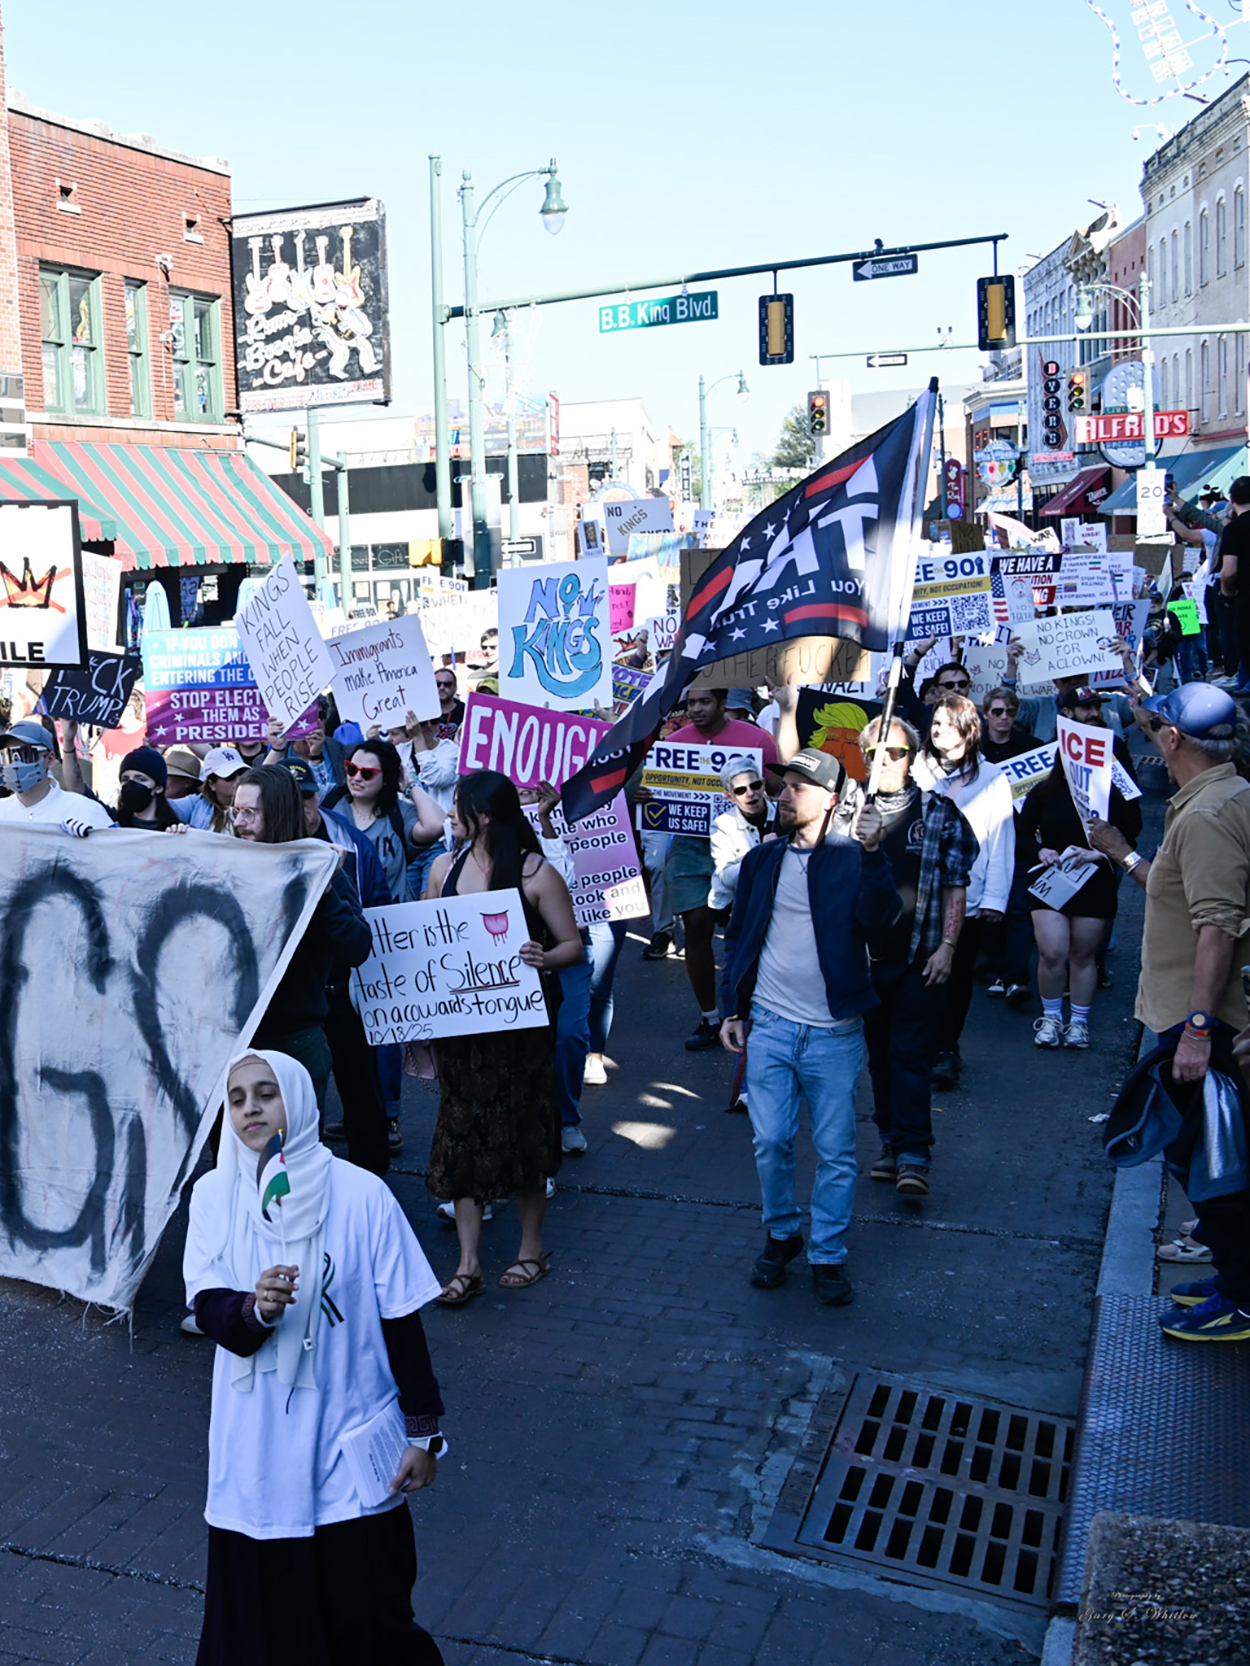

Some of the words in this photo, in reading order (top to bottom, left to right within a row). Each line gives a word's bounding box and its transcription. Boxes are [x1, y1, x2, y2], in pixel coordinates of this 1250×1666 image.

[870, 263, 891, 274] ONE
[892, 260, 912, 272] WAY
[601, 304, 636, 331] B.B.
[637, 301, 670, 325] King
[676, 296, 717, 321] Blvd.
[1045, 362, 1059, 446] DYERS
[1082, 413, 1188, 442] ALFRD'S
[1141, 485, 1163, 499] 20
[607, 505, 623, 518] NO
[617, 508, 648, 537] KINGS
[1000, 558, 1017, 574] WE
[1017, 556, 1044, 572] HAVE
[1045, 555, 1054, 571] A
[523, 572, 582, 624] NO
[929, 584, 941, 594] NOT
[942, 580, 984, 592] OCCUPATION!
[240, 562, 291, 637] KINGS
[653, 617, 677, 635] NO
[910, 613, 925, 625] WE
[925, 610, 948, 623] KEEP
[1037, 619, 1053, 634] NO
[1053, 614, 1096, 631] KINGS!
[255, 617, 291, 653] FALL
[912, 625, 924, 637] US
[925, 623, 949, 636] SAFE!
[1038, 633, 1055, 647] NO
[1055, 627, 1099, 644] CROWN
[181, 636, 210, 651] YOU
[261, 627, 301, 680] WHEN
[330, 628, 404, 668] Immigrants
[1056, 642, 1081, 656] FOR
[150, 652, 221, 670] CRIMINALS
[507, 612, 604, 700] KINGS
[988, 659, 1006, 670] NO
[1057, 652, 1106, 671] CLOWN!
[151, 669, 215, 686] ENTERING
[219, 668, 245, 682] THE
[264, 637, 319, 708] PEOPLE
[344, 667, 376, 692] make
[375, 661, 419, 684] America
[51, 685, 125, 722] TRUMP
[170, 691, 211, 710] STOP
[284, 671, 321, 721] RISE
[362, 684, 407, 721] Great
[201, 708, 239, 724] THEM
[243, 707, 260, 721] AS
[465, 703, 610, 794] ENOUG
[644, 746, 700, 771] FREE
[1061, 728, 1106, 768] ICE
[645, 772, 690, 786] OPPORTUNITY,
[692, 777, 705, 786] NOT
[1069, 761, 1093, 793] OUT
[653, 788, 663, 797] THE
[662, 790, 692, 800] MOVEMENT
[668, 803, 683, 816] WE
[684, 804, 708, 818] KEEP
[582, 814, 617, 831] who
[668, 817, 680, 830] US
[681, 819, 708, 832] SAFE!
[570, 832, 628, 855] people
[581, 866, 639, 889] people
[610, 880, 641, 899] and
[581, 908, 611, 924] like
[614, 900, 646, 918] you
[423, 924, 437, 947] is
[436, 908, 470, 944] the
[355, 961, 407, 1003] taste
[414, 958, 437, 993] of
[440, 950, 522, 990] Silence
[363, 1007, 390, 1028] on
[390, 1006, 404, 1024] a
[403, 994, 473, 1023] coward's
[471, 989, 544, 1024] tongue
